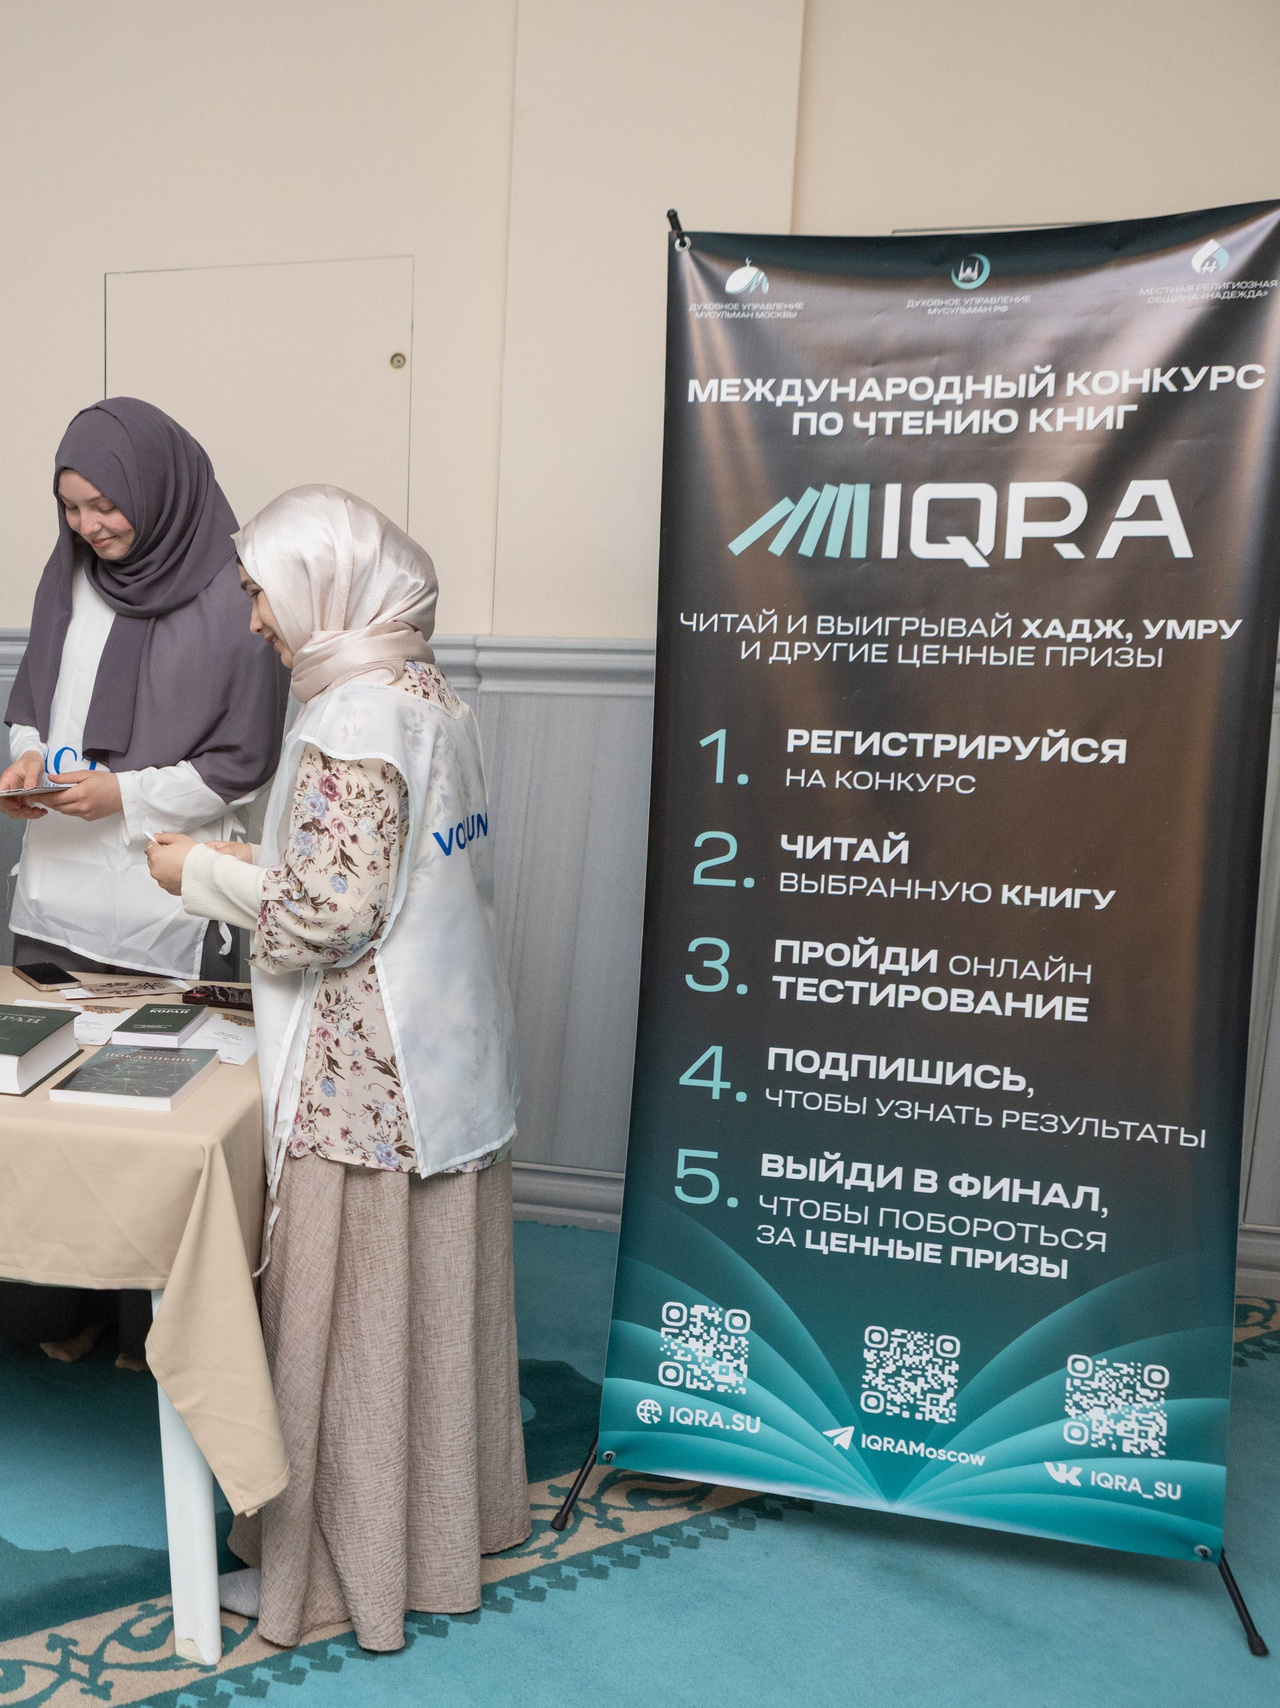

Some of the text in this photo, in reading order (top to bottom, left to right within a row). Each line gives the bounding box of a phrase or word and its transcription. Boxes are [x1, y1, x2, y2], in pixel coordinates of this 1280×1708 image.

[906, 295, 1031, 309] ДУХОВНОЕ УПРАВЛЕНИЕ
[1195, 280, 1279, 293] РЕЛИГИОЗНАЯ
[689, 302, 804, 312] ДУХОВНОЕ УПРАВЛЕНИЕ
[695, 310, 798, 320] МУСУЛЬМАН МОСКВЫ
[927, 306, 992, 316] МУСУЛЬМАН
[688, 363, 1266, 406] МЕЖДУНАРОДНЫЙ КОНКУРС
[793, 404, 1138, 435] ПО ЧТЕНИЮ КНИГ
[882, 478, 1193, 567] IQRA
[681, 609, 1242, 643] ЧИТАЙ И ВЫИГРЫВАЙ ХАДЖ, УМРУ
[741, 641, 1162, 668] И ДРУГИЕ ЦЕННЫЕ ПРИЗЫ
[700, 729, 1127, 784] 1. РЕГИСТРИРУЙСЯ
[786, 769, 976, 794] НА КОНКУРС
[693, 831, 909, 888] 2. ЧИТАЙ
[780, 872, 1116, 909] ВЫБРАННУЮ КНИГУ
[686, 937, 1091, 994] 3. ПРОЙДИ ОНЛАЙН
[773, 977, 1089, 1022] ТЕСТИРОВАНИЕ
[679, 1046, 1033, 1102] 4. ПОДПИШИСЬ,
[766, 1089, 1205, 1148] ЧТОБЫ УЗНАТЬ РЕЗУЛЬТАТЫ
[675, 1149, 1108, 1218] 5. ВЫЙДИ В ФИНАЛ,
[760, 1195, 1108, 1253] ЧТОБЫ ПОБОРОТЬСЯ
[757, 1225, 1068, 1279] ЗА ЦЕННЫЕ ПРИЗЫ
[670, 1404, 763, 1436] IQRA.SU
[862, 1434, 988, 1469] IQRAMoscow
[1089, 1471, 1181, 1499] IQRA_SU
